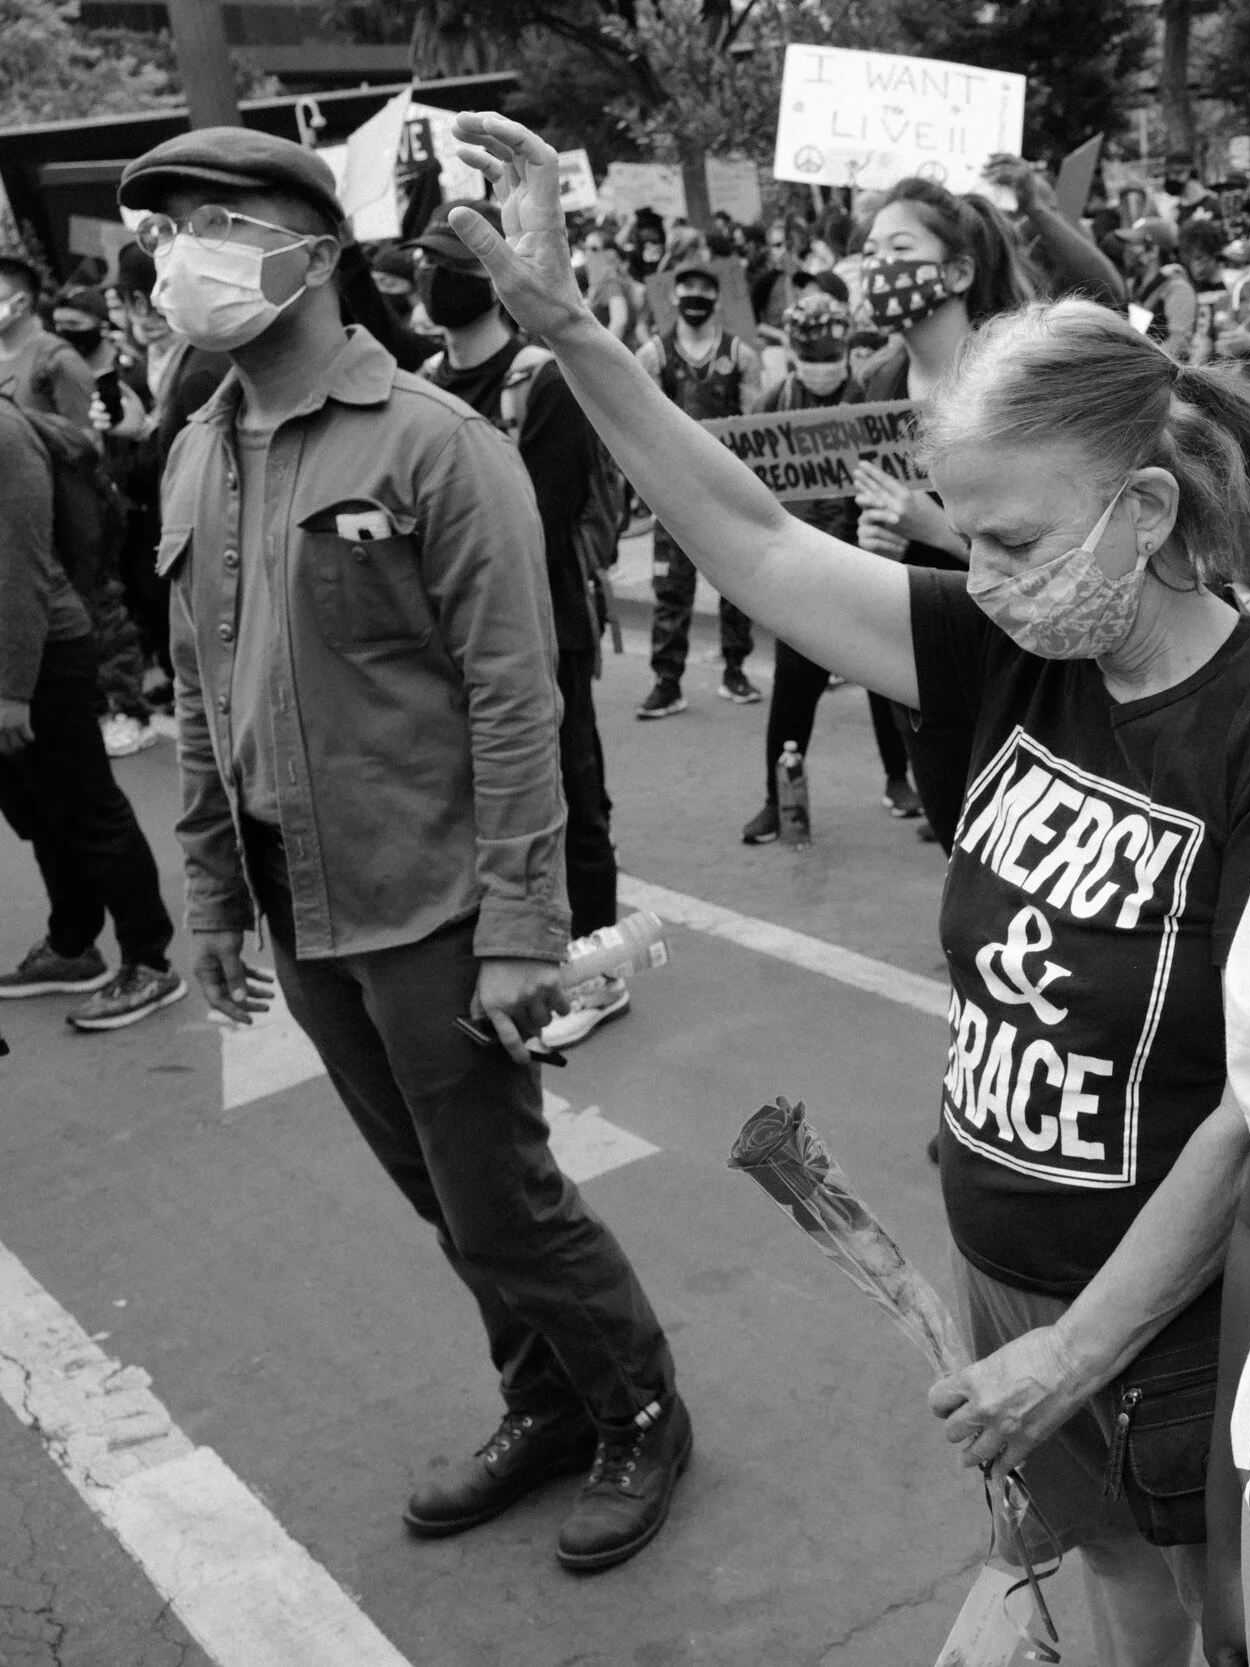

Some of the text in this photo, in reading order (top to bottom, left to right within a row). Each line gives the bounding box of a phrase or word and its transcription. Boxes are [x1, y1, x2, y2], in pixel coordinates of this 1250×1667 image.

[804, 54, 987, 104] I WANT
[719, 421, 796, 461] HAPPY
[753, 457, 853, 492] REONNA
[960, 755, 1182, 929] MERCY
[975, 905, 1072, 1025] &
